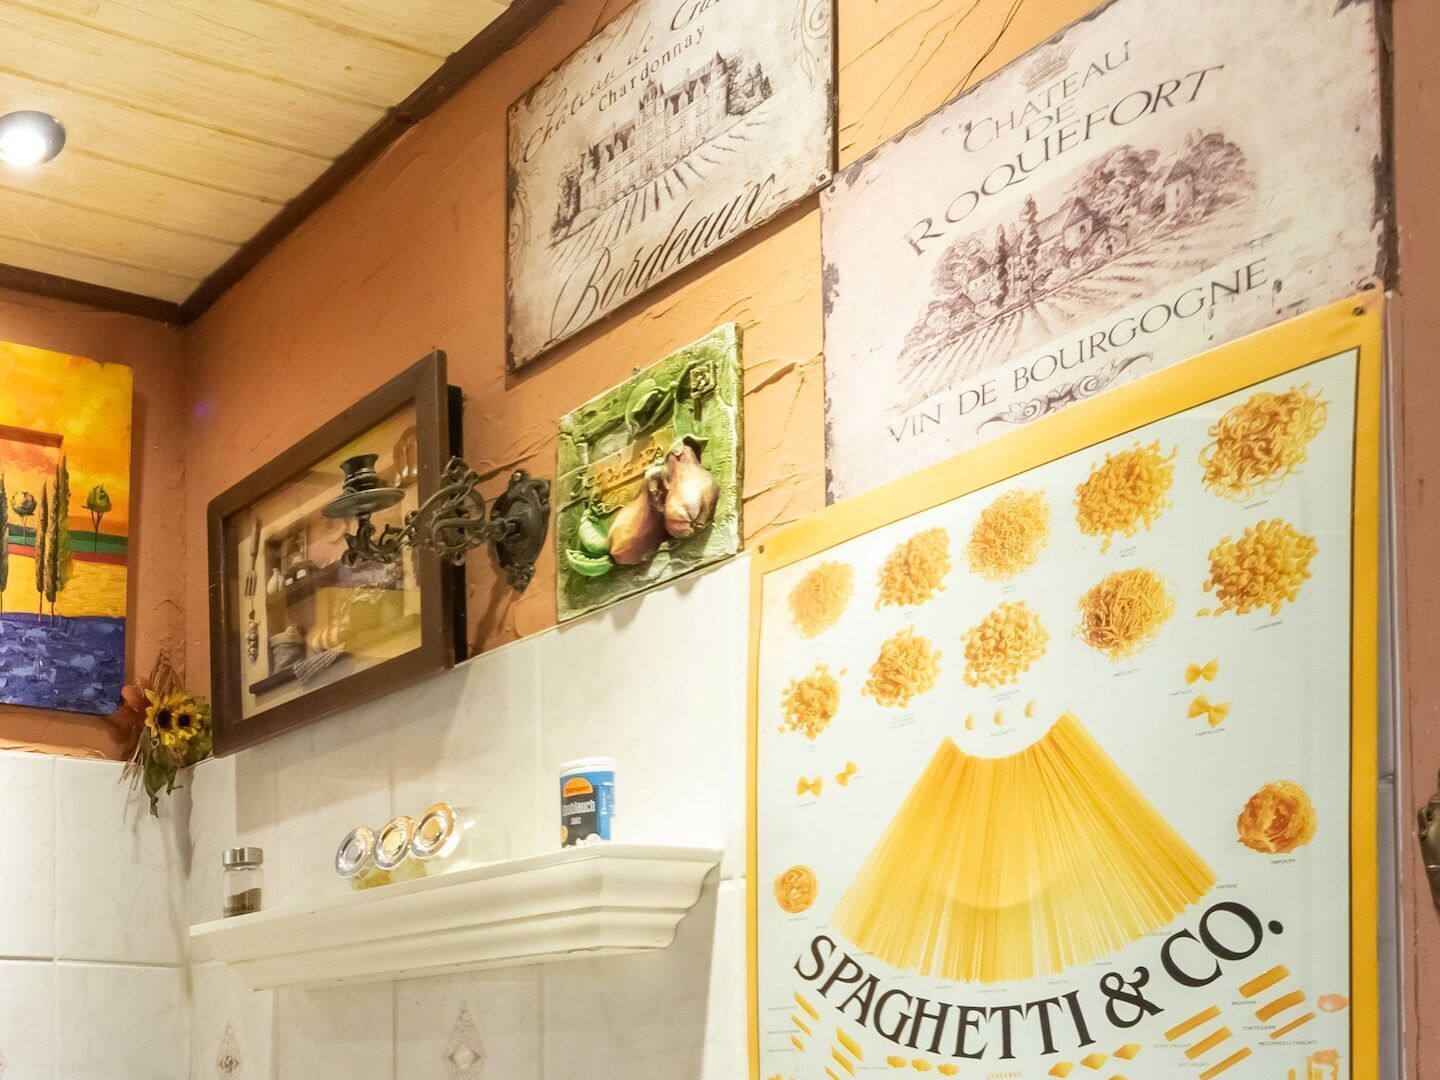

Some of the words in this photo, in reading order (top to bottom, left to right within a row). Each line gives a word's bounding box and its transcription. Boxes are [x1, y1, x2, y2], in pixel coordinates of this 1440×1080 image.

[597, 25, 705, 113] Chardonnay
[963, 39, 1131, 153] CHATEAU
[1024, 97, 1077, 144] DE
[902, 64, 1225, 257] ROQUEFORT
[542, 172, 777, 349] Bordeaux
[886, 402, 943, 444] VIN
[957, 378, 998, 417] DE
[1012, 257, 1270, 394] BOURGOGNE
[793, 934, 1096, 1061] SPAGHETTI
[1098, 965, 1165, 1030] &
[1159, 899, 1285, 989] CO.
